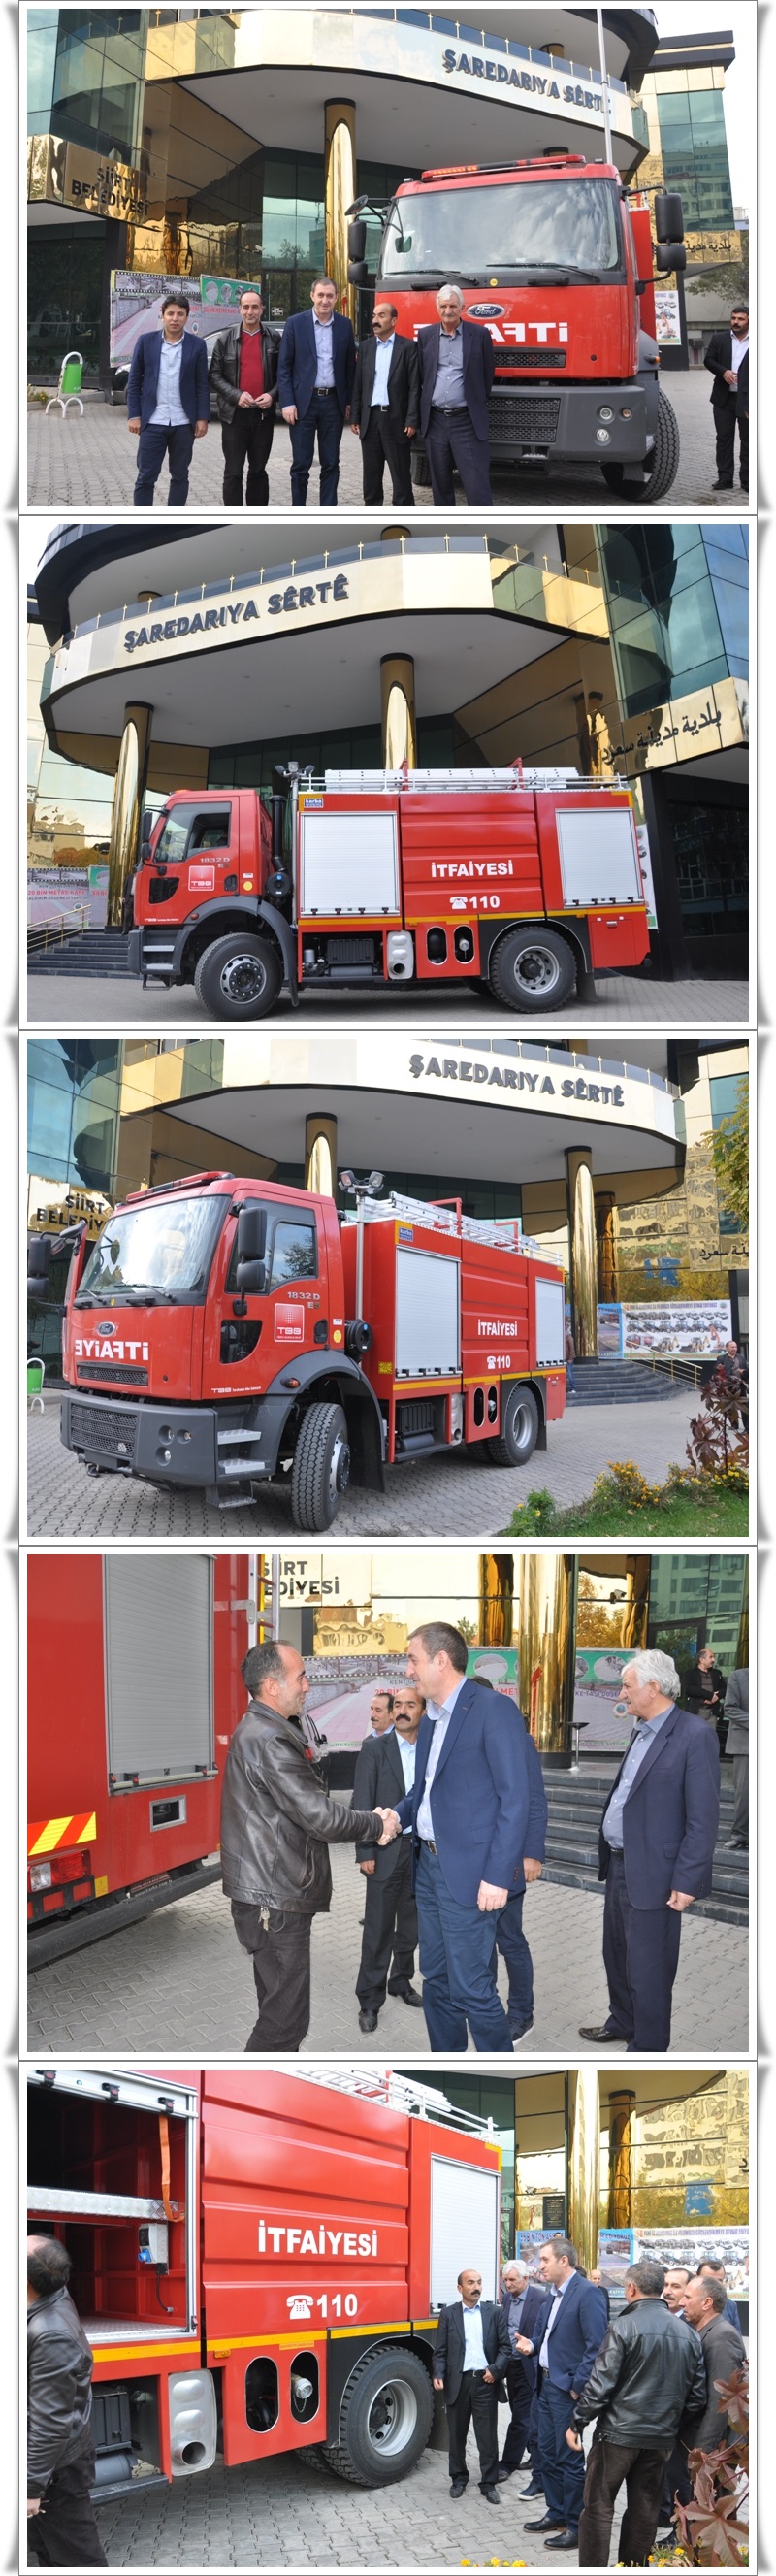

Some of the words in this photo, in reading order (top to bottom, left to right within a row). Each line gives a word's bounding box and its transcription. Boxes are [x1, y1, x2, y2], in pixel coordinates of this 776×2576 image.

[442, 49, 560, 98] ŞAREDARIYA
[123, 600, 261, 653] ŞAREDARIYA
[267, 573, 350, 614] SÊRTÊ
[431, 859, 514, 878] İTFAİYESİ
[469, 895, 501, 909] 110
[409, 1054, 556, 1094] ŞAREDARIYA
[561, 1077, 625, 1107] SÊRTÊ
[65, 1193, 105, 1214] SİİRT
[37, 1208, 107, 1231] BELEDİY
[287, 1291, 311, 1300] 1832
[477, 1319, 518, 1336] İTFAİYESİ
[497, 1355, 511, 1369] 110
[264, 1558, 308, 1577] SRT
[258, 2219, 377, 2257] İTFAİYESİ
[316, 2293, 358, 2318] 110
